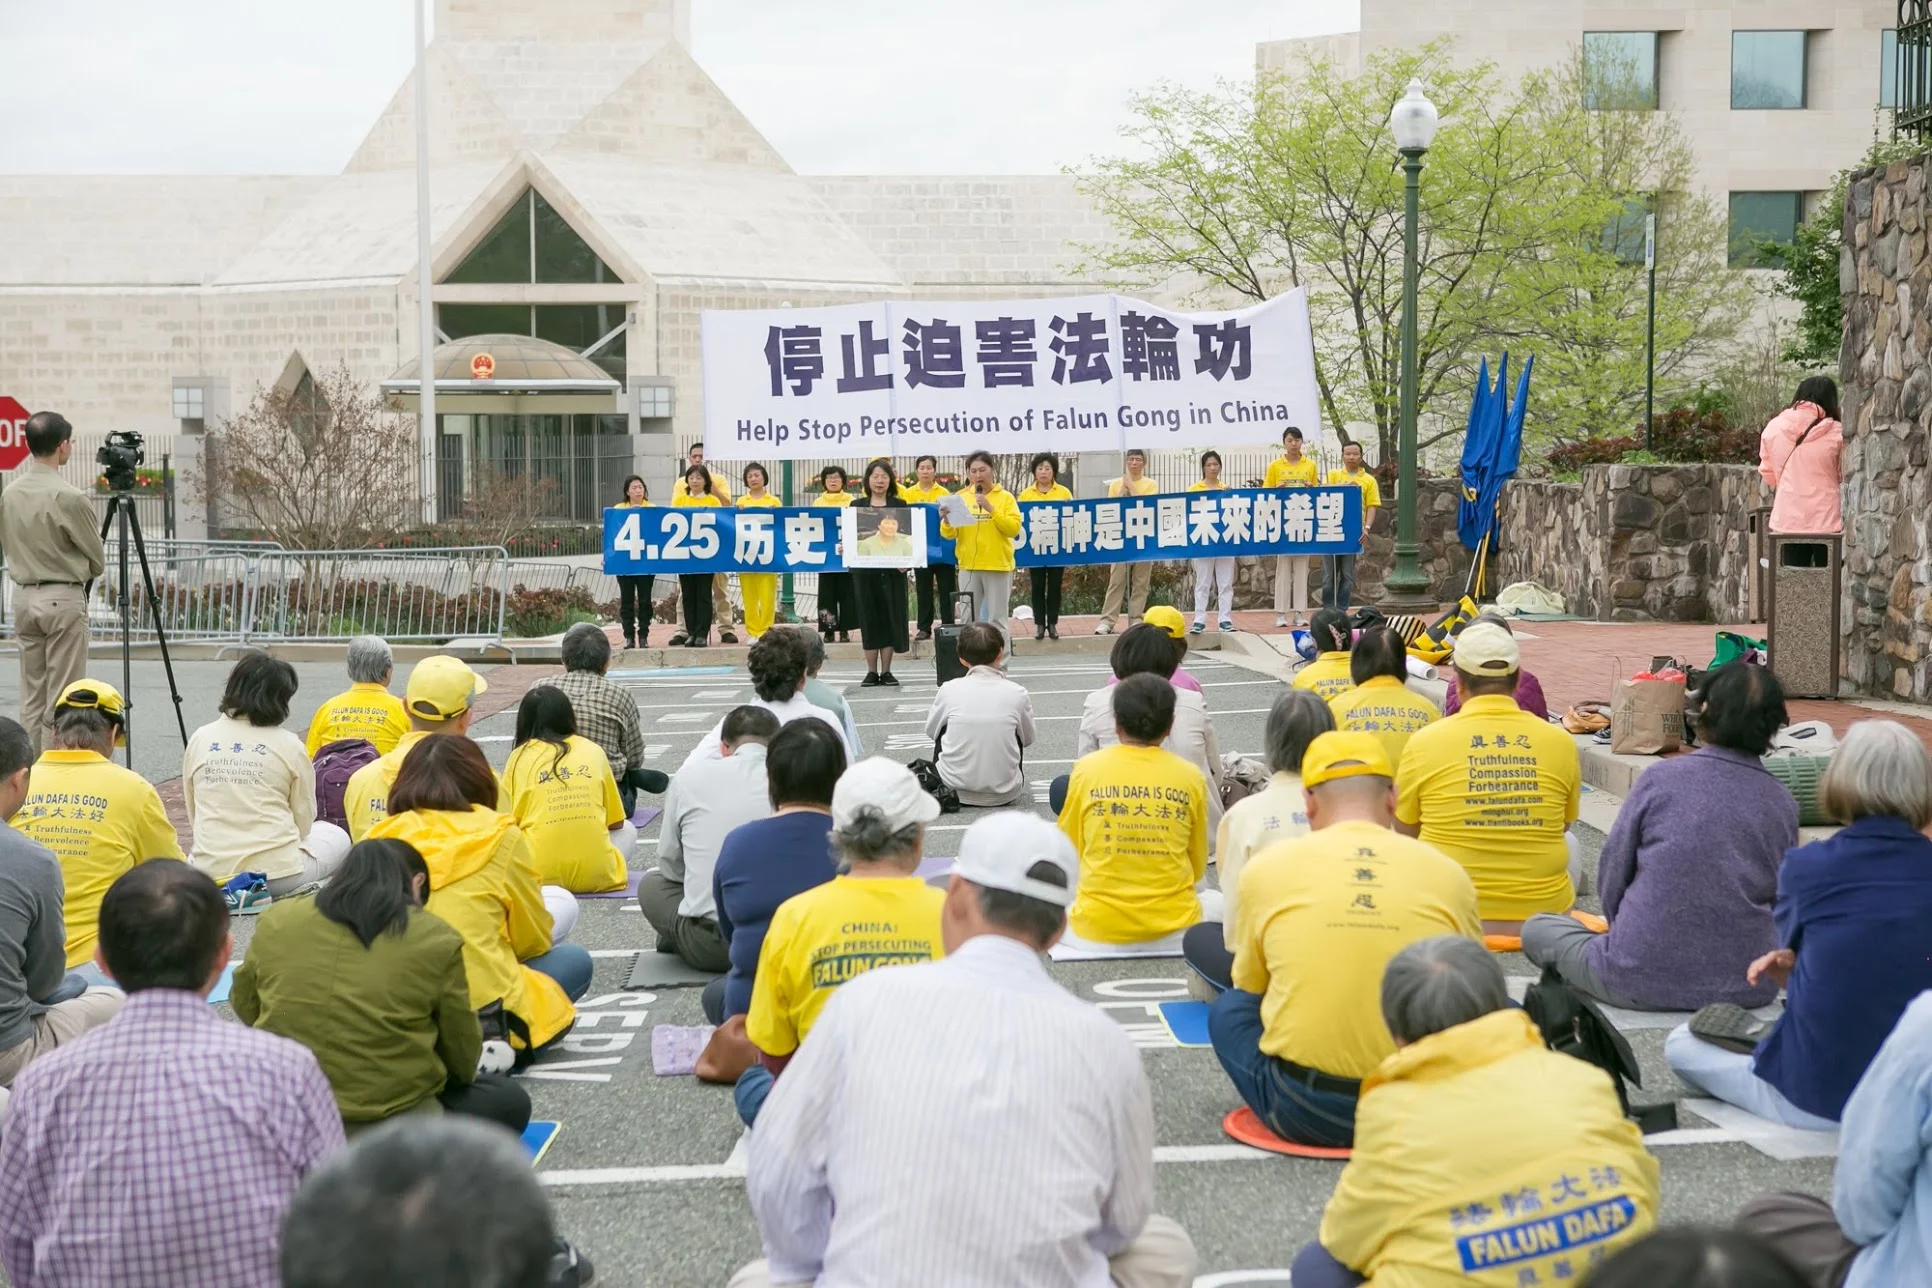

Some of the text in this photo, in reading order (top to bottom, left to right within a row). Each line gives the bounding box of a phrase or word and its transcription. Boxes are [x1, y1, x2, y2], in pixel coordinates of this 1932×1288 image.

[764, 311, 1252, 397] 停止迫害法輪功
[737, 400, 1289, 446] Help Stop Persecution of Falun Gong in China
[614, 513, 720, 561] 4.25
[734, 512, 841, 566] 历史
[1374, 707, 1396, 717] DAFA
[1398, 708, 1405, 718] IS
[1408, 708, 1428, 722] GOOD
[1468, 754, 1537, 766] Truthfulness
[1469, 767, 1537, 780] Compassion
[1468, 781, 1539, 793] Forbearance
[46, 793, 69, 805] DAFA
[71, 794, 80, 805] IS
[82, 795, 108, 810] GOOD
[1090, 785, 1190, 805] FALUN DAFA IS GOOD
[549, 802, 591, 811] Forbearance
[35, 824, 92, 835] Truthfulness
[841, 922, 898, 934] CHINA:
[844, 939, 932, 953] PERSECUTING
[1469, 1200, 1628, 1267] FALUN DAFA
